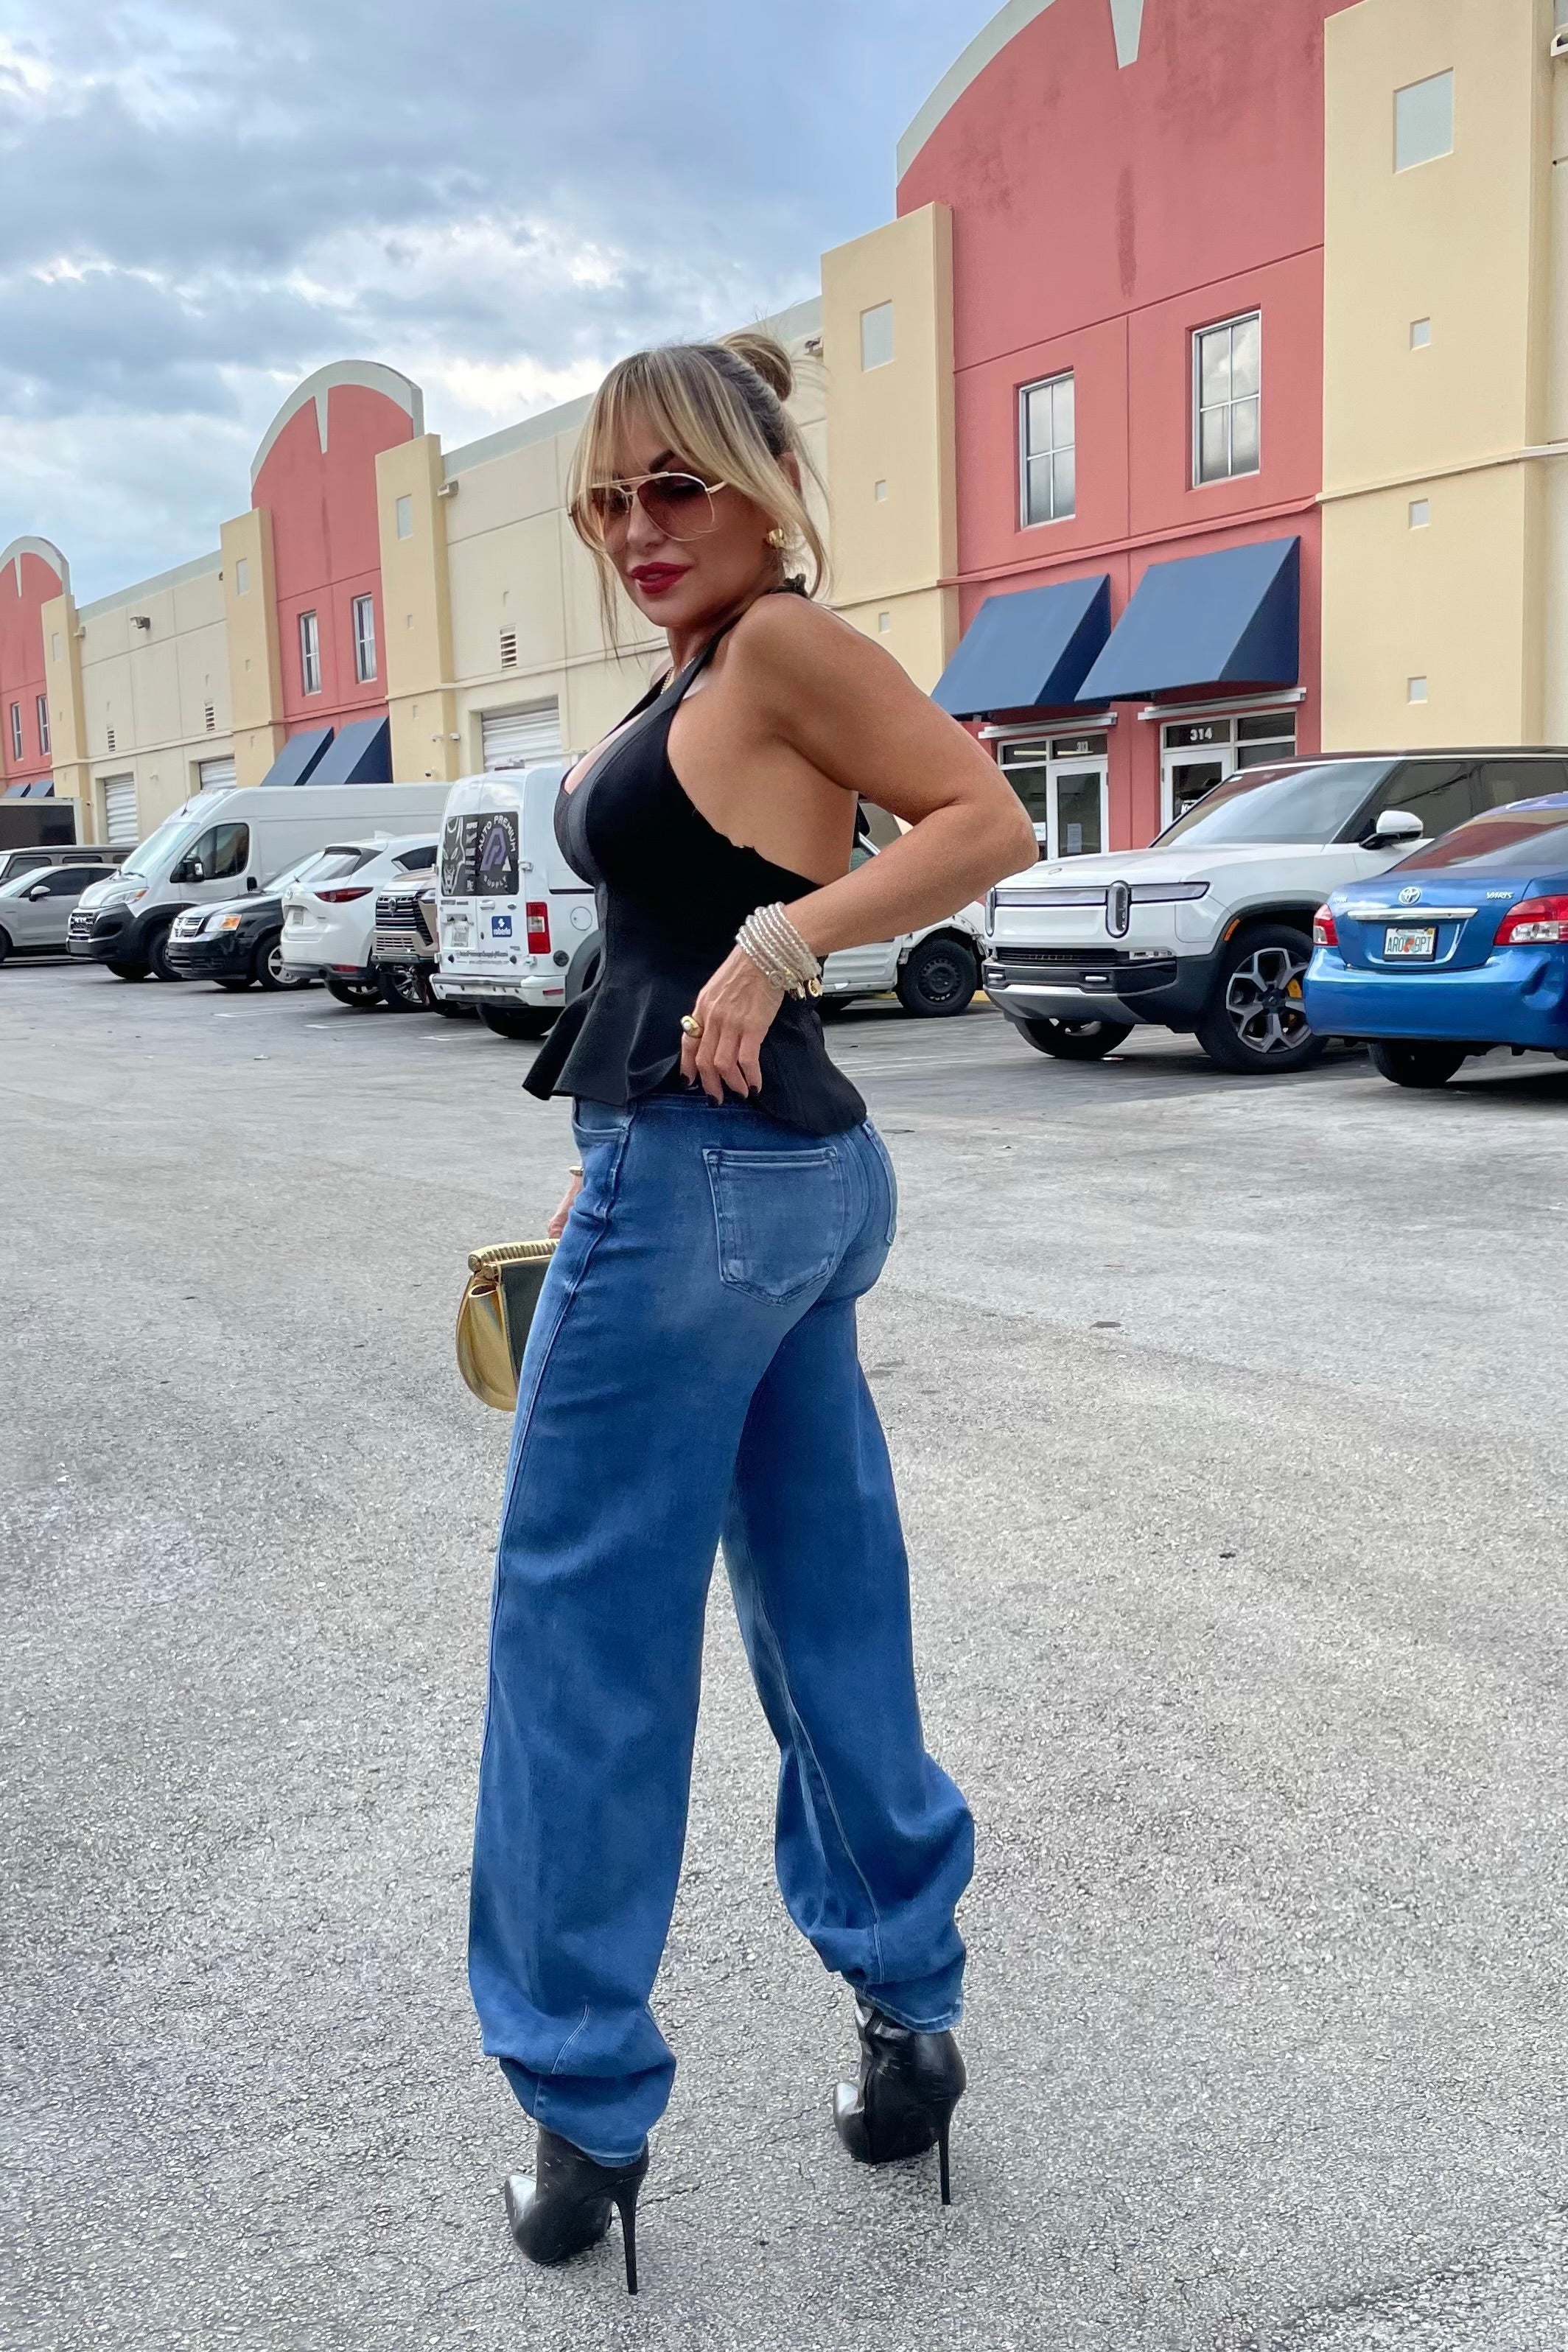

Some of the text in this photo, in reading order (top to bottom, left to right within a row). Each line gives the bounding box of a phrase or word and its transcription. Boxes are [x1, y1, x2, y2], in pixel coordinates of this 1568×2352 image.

[1190, 727, 1213, 741] 314
[478, 815, 516, 853] AUTO PREMIUM
[1485, 891, 1514, 900] YARIS
